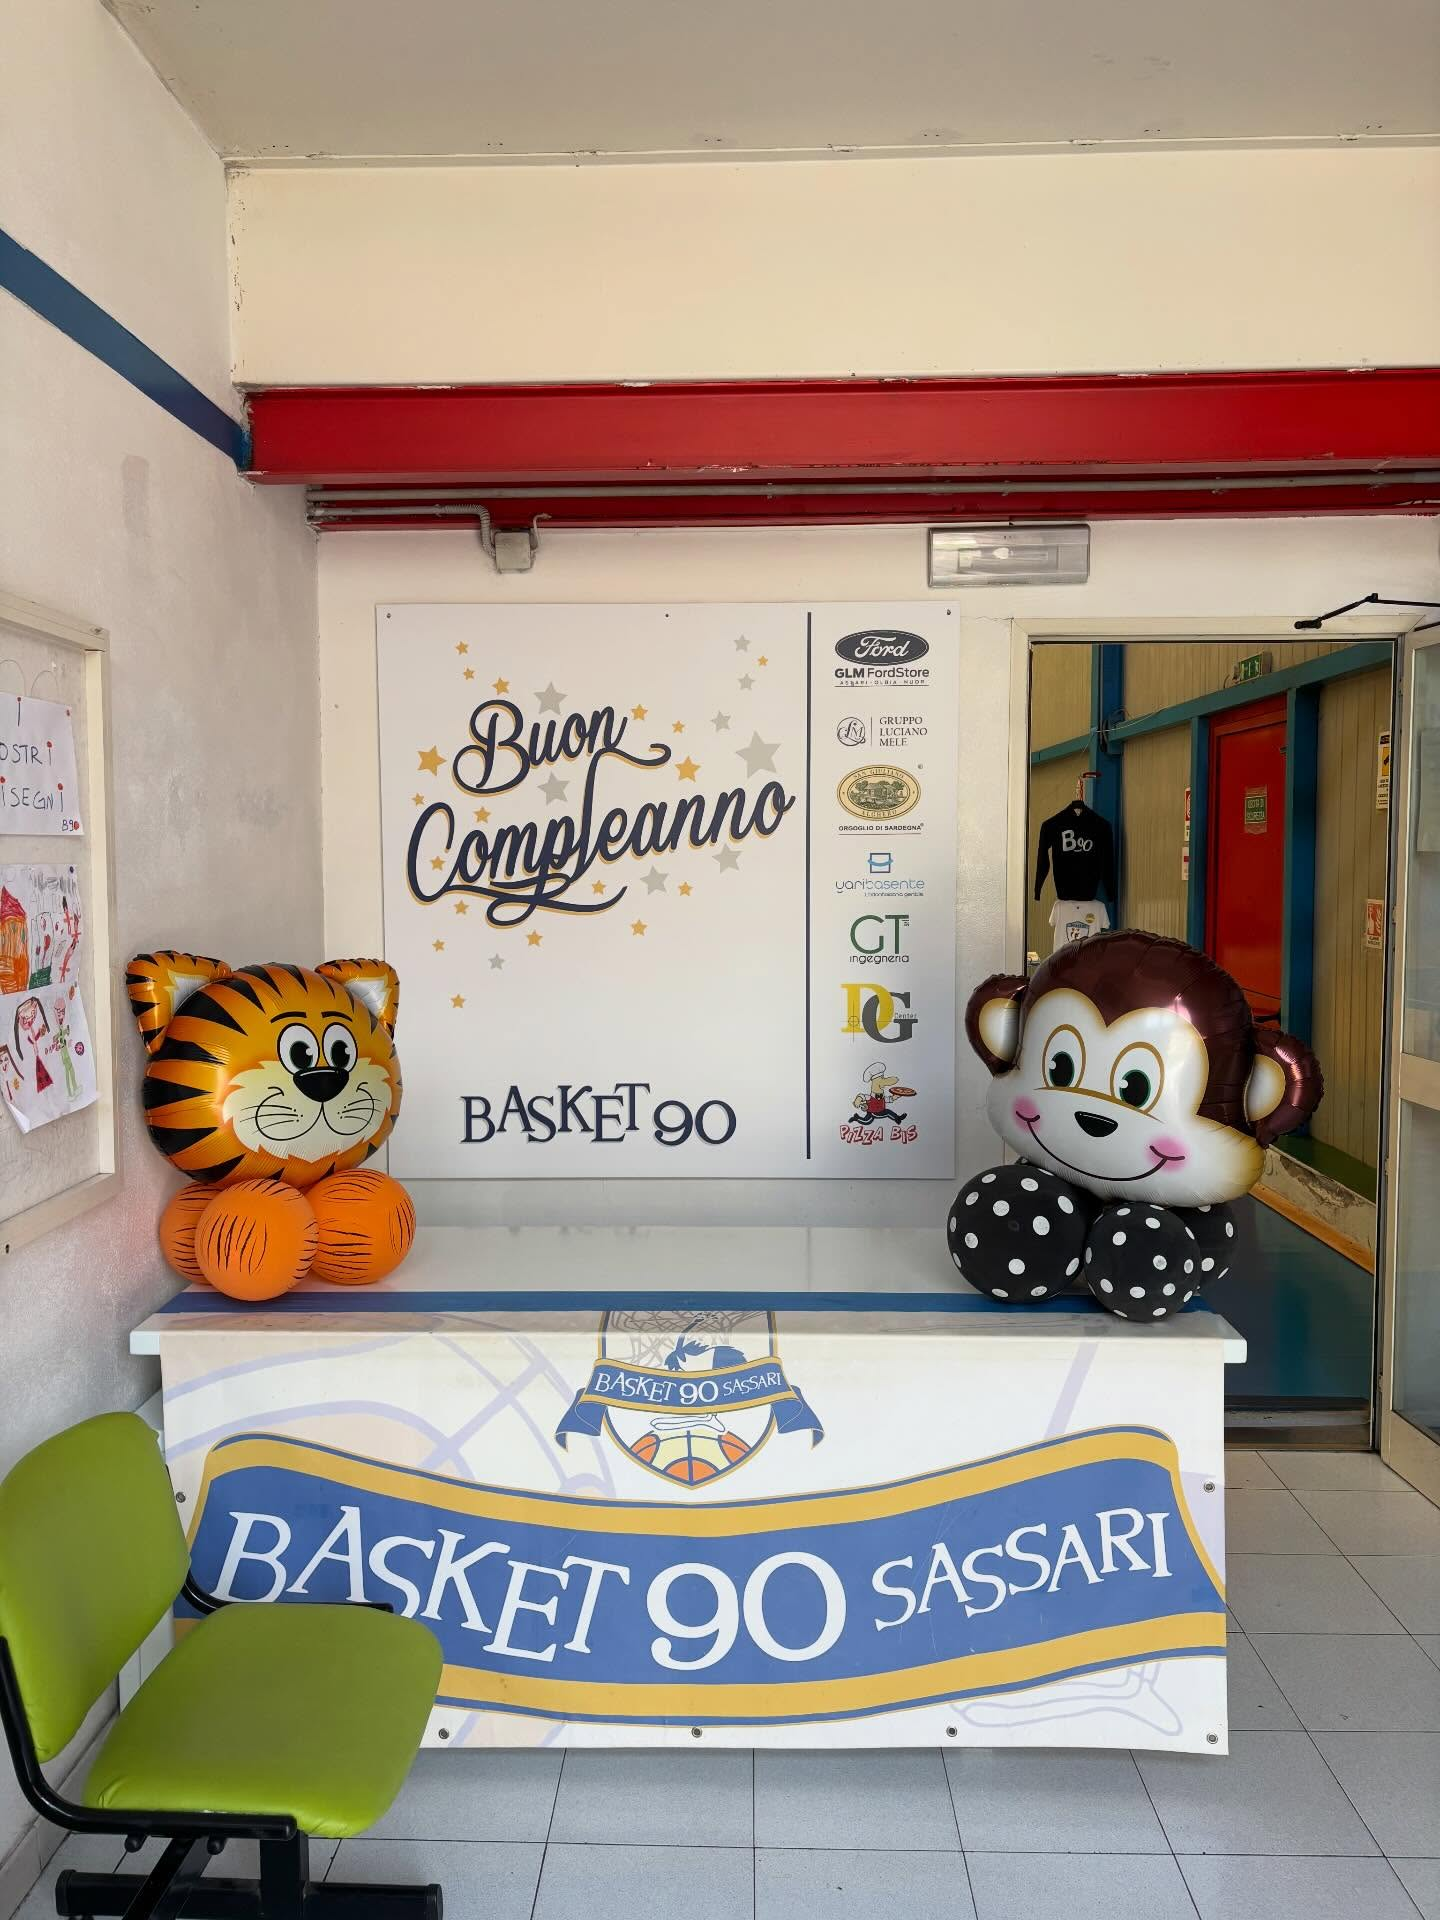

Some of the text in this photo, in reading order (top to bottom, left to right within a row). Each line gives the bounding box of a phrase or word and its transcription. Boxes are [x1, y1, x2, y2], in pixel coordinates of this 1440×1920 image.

[854, 635, 911, 658] Ford
[834, 667, 930, 679] GLM FordStore
[879, 716, 923, 726] GRUPPO
[879, 728, 928, 737] LUCIANO
[453, 699, 628, 794] Buon
[407, 744, 797, 928] Compleanno
[850, 914, 910, 955] GT
[849, 954, 910, 965] ingegneria
[459, 1083, 737, 1146] BASKET 90
[839, 1124, 918, 1145] PIZZA BIS
[594, 1371, 782, 1405] BASKET 90 SASSARI
[214, 1505, 1173, 1670] BASKET 90 SASSARI
